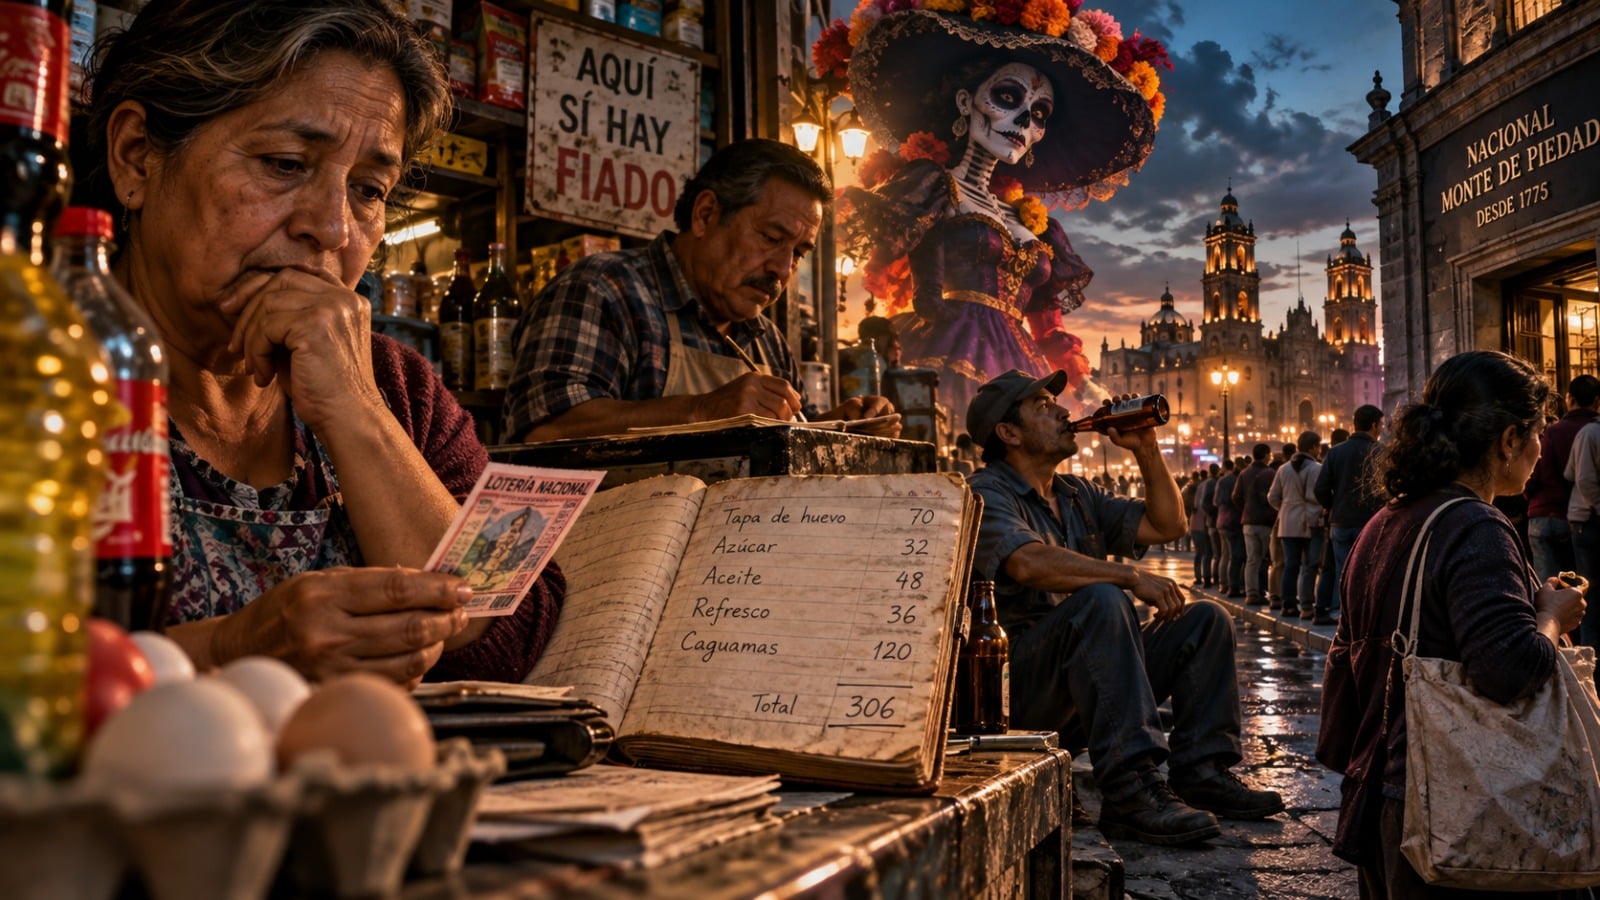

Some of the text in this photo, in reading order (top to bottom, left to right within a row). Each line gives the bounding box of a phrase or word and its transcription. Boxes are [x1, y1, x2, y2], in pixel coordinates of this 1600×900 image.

[576, 47, 657, 100] AQUÍ
[558, 91, 672, 155] SÍ HAY
[1466, 104, 1555, 168] NACIONAL
[556, 146, 676, 217] FIADO
[1441, 118, 1600, 214] MONTE DE PIEDAD
[1476, 181, 1549, 228] DESDE 1775
[483, 475, 591, 496] LOTERÍA NACIONAL
[723, 505, 935, 532] Tapa de huevo 70
[711, 535, 928, 556] Azúcar 32
[702, 566, 924, 590] Aceite 48
[691, 597, 916, 626] Refresco 36
[680, 630, 912, 663] Caguamas 120
[751, 693, 896, 719] Total 306
